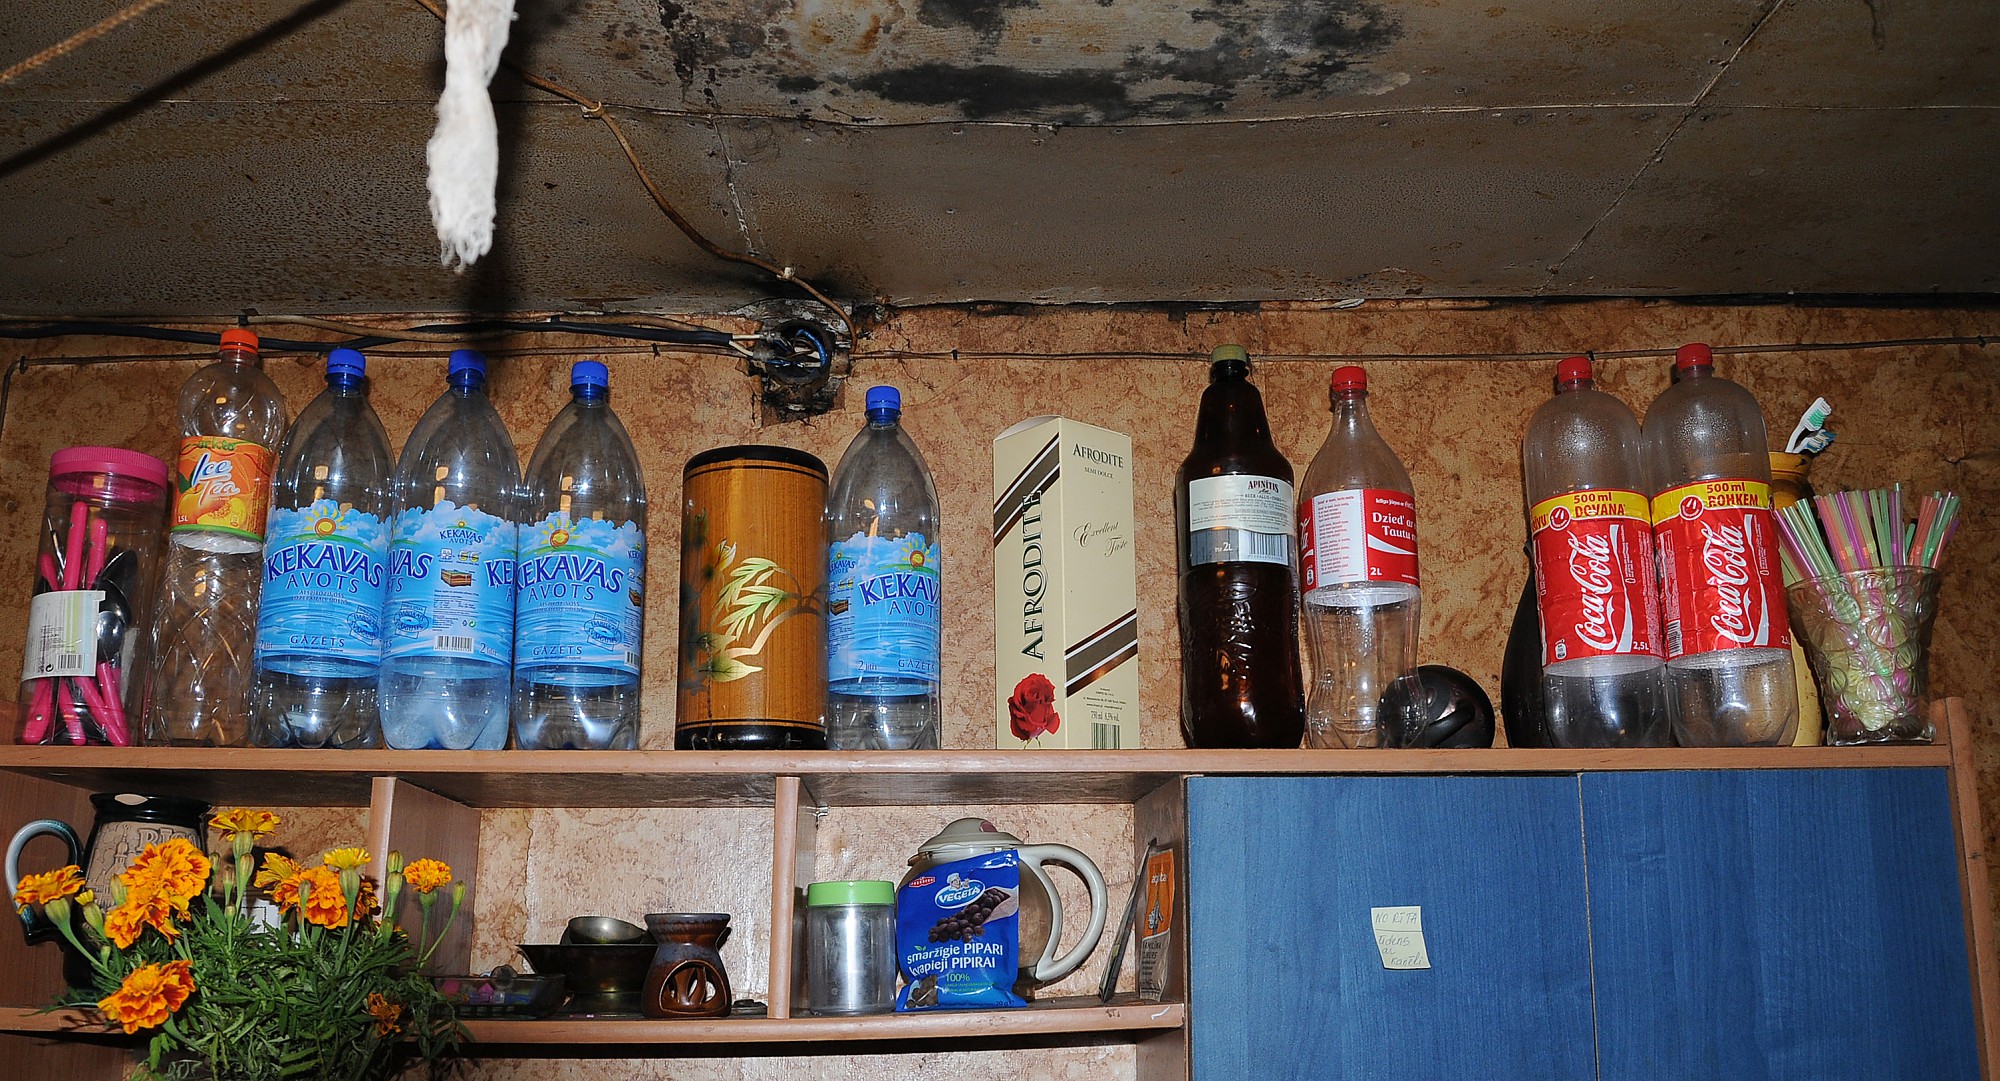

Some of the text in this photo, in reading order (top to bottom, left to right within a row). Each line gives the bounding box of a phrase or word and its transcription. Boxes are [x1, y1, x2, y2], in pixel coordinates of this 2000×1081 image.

[1073, 443, 1123, 469] AFRODITE
[192, 452, 233, 488] Ice
[198, 473, 240, 508] Tea
[1706, 482, 1746, 494] 500 ml
[1573, 491, 1612, 504] 500 ml
[1707, 493, 1759, 508] ROHKEM
[1073, 521, 1119, 548] Excellent
[1381, 525, 1411, 540] Tautu
[1104, 534, 1128, 558] Taste
[1222, 541, 1233, 552] 2L
[1021, 489, 1048, 663] AFRODITE
[1370, 566, 1383, 576] 2L
[285, 571, 360, 594] AVOTS
[527, 581, 596, 602] AVOTS
[480, 642, 487, 654] 2
[1633, 641, 1650, 651] 2,5L
[857, 660, 865, 671] 2
[938, 885, 981, 903] VEGETA
[1375, 912, 1389, 923] NO
[963, 942, 1003, 956] PIPARI
[908, 956, 996, 978] kvapieji PIPIRAI
[945, 973, 971, 982] 100%
